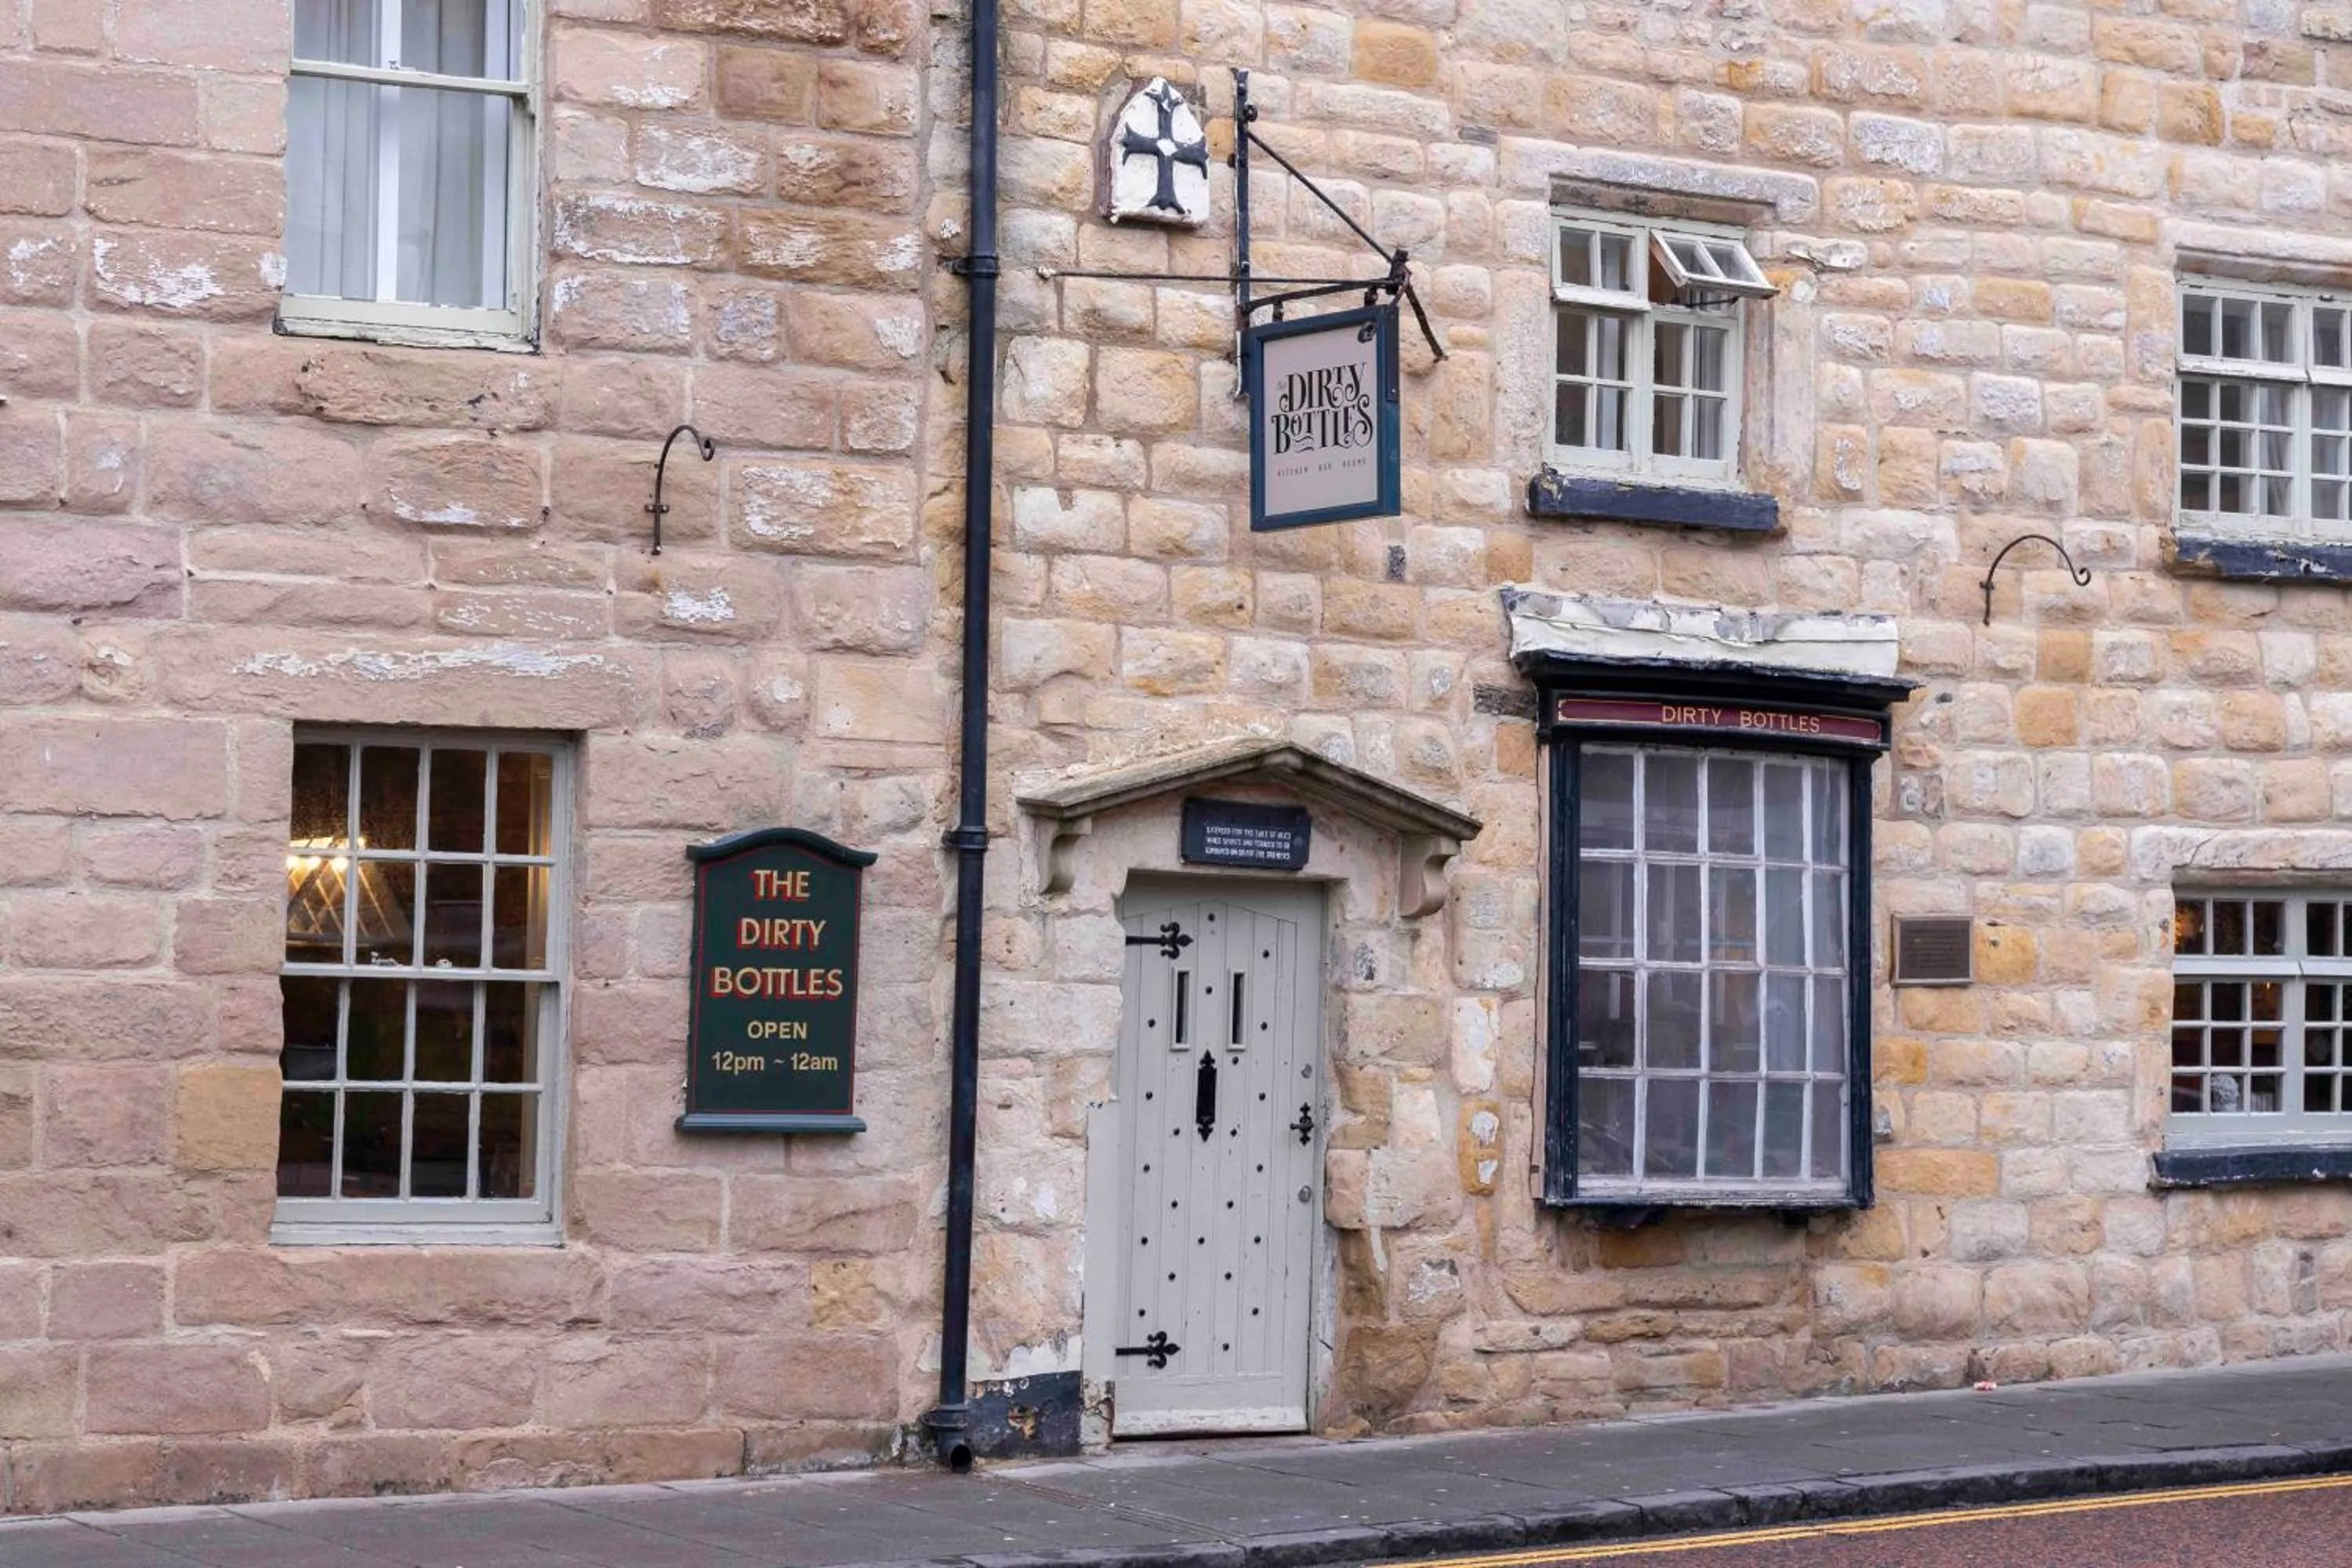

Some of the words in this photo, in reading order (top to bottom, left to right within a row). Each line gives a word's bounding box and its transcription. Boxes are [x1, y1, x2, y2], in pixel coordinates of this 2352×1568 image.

[1279, 362, 1367, 413] DIRTY
[1271, 394, 1374, 456] BOTTLES
[1662, 706, 1722, 725] DIRTY
[1740, 710, 1820, 733] BOTTLES
[751, 869, 811, 900] THE
[739, 916, 827, 949] DIRTY
[710, 966, 844, 998] BOTTLES
[747, 1020, 808, 1040] OPEN
[711, 1051, 765, 1076] 12pm
[790, 1052, 839, 1072] 12am
